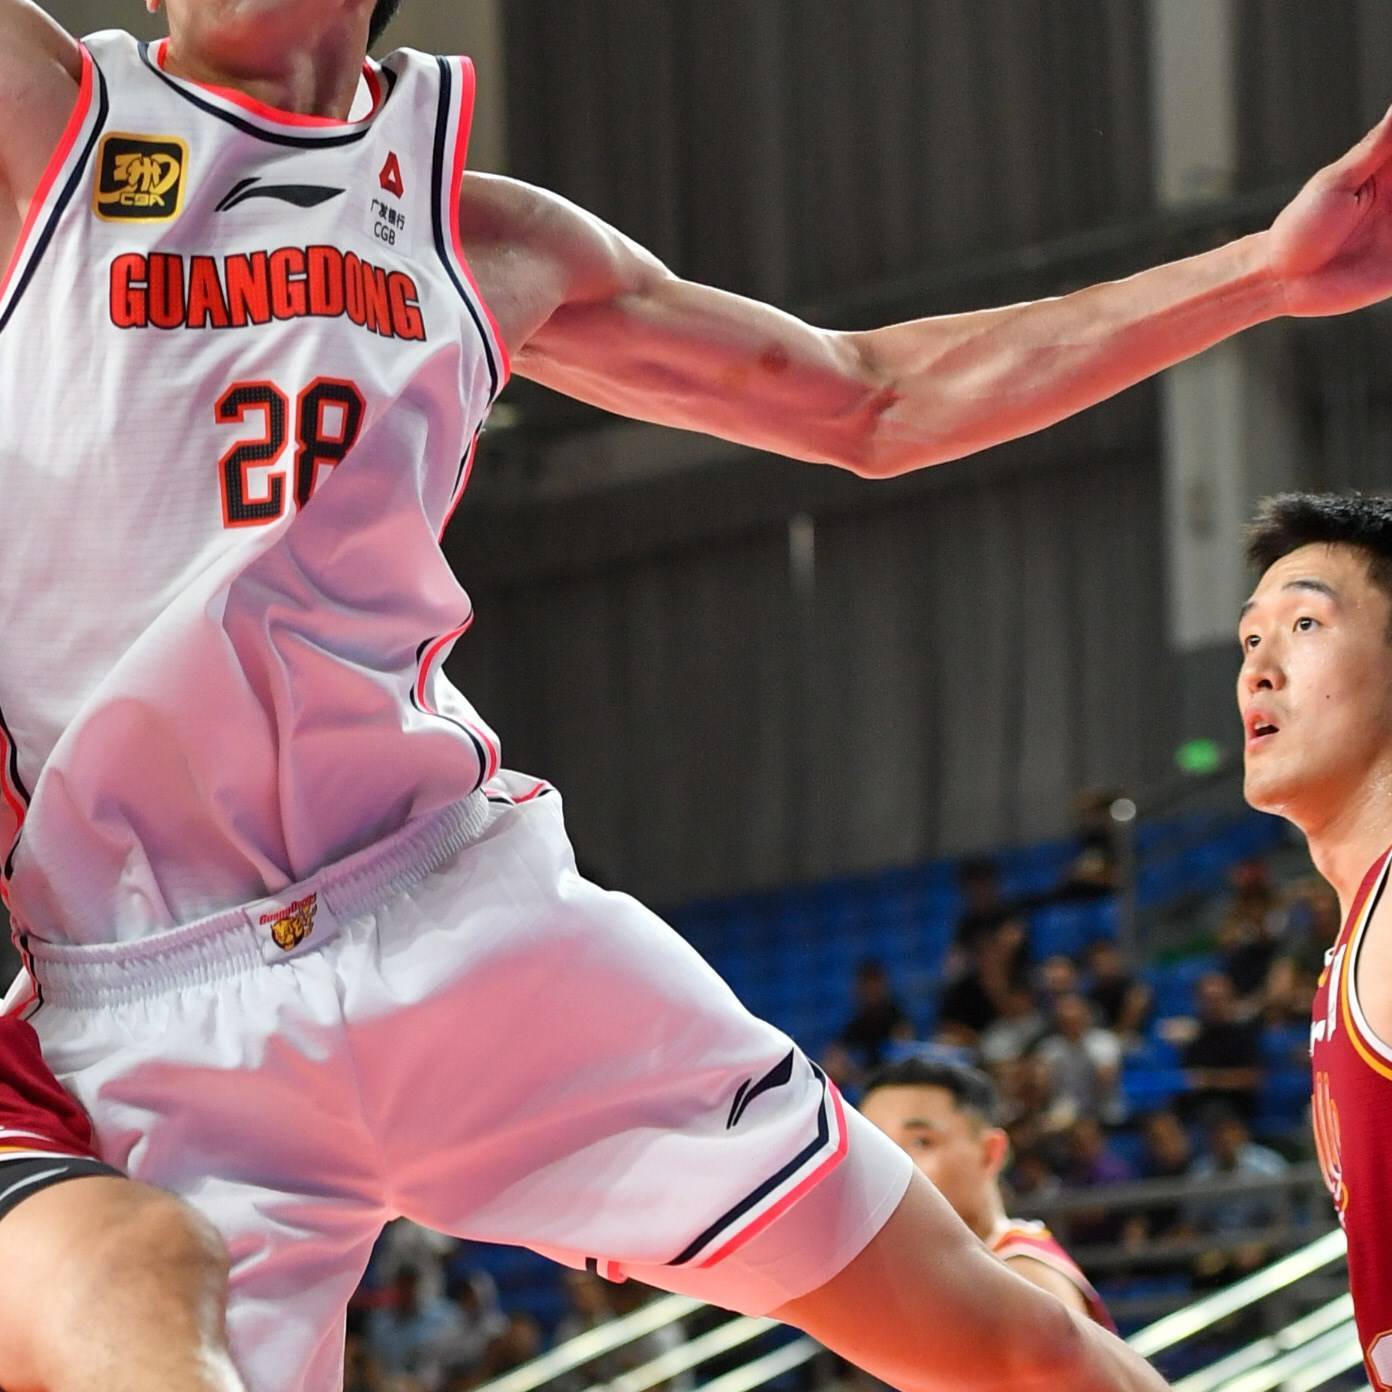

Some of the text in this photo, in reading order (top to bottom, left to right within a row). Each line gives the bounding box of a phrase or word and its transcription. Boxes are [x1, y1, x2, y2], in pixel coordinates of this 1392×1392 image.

[374, 221, 396, 246] CGB
[109, 246, 426, 341] GUANGDONG
[214, 377, 366, 528] 28
